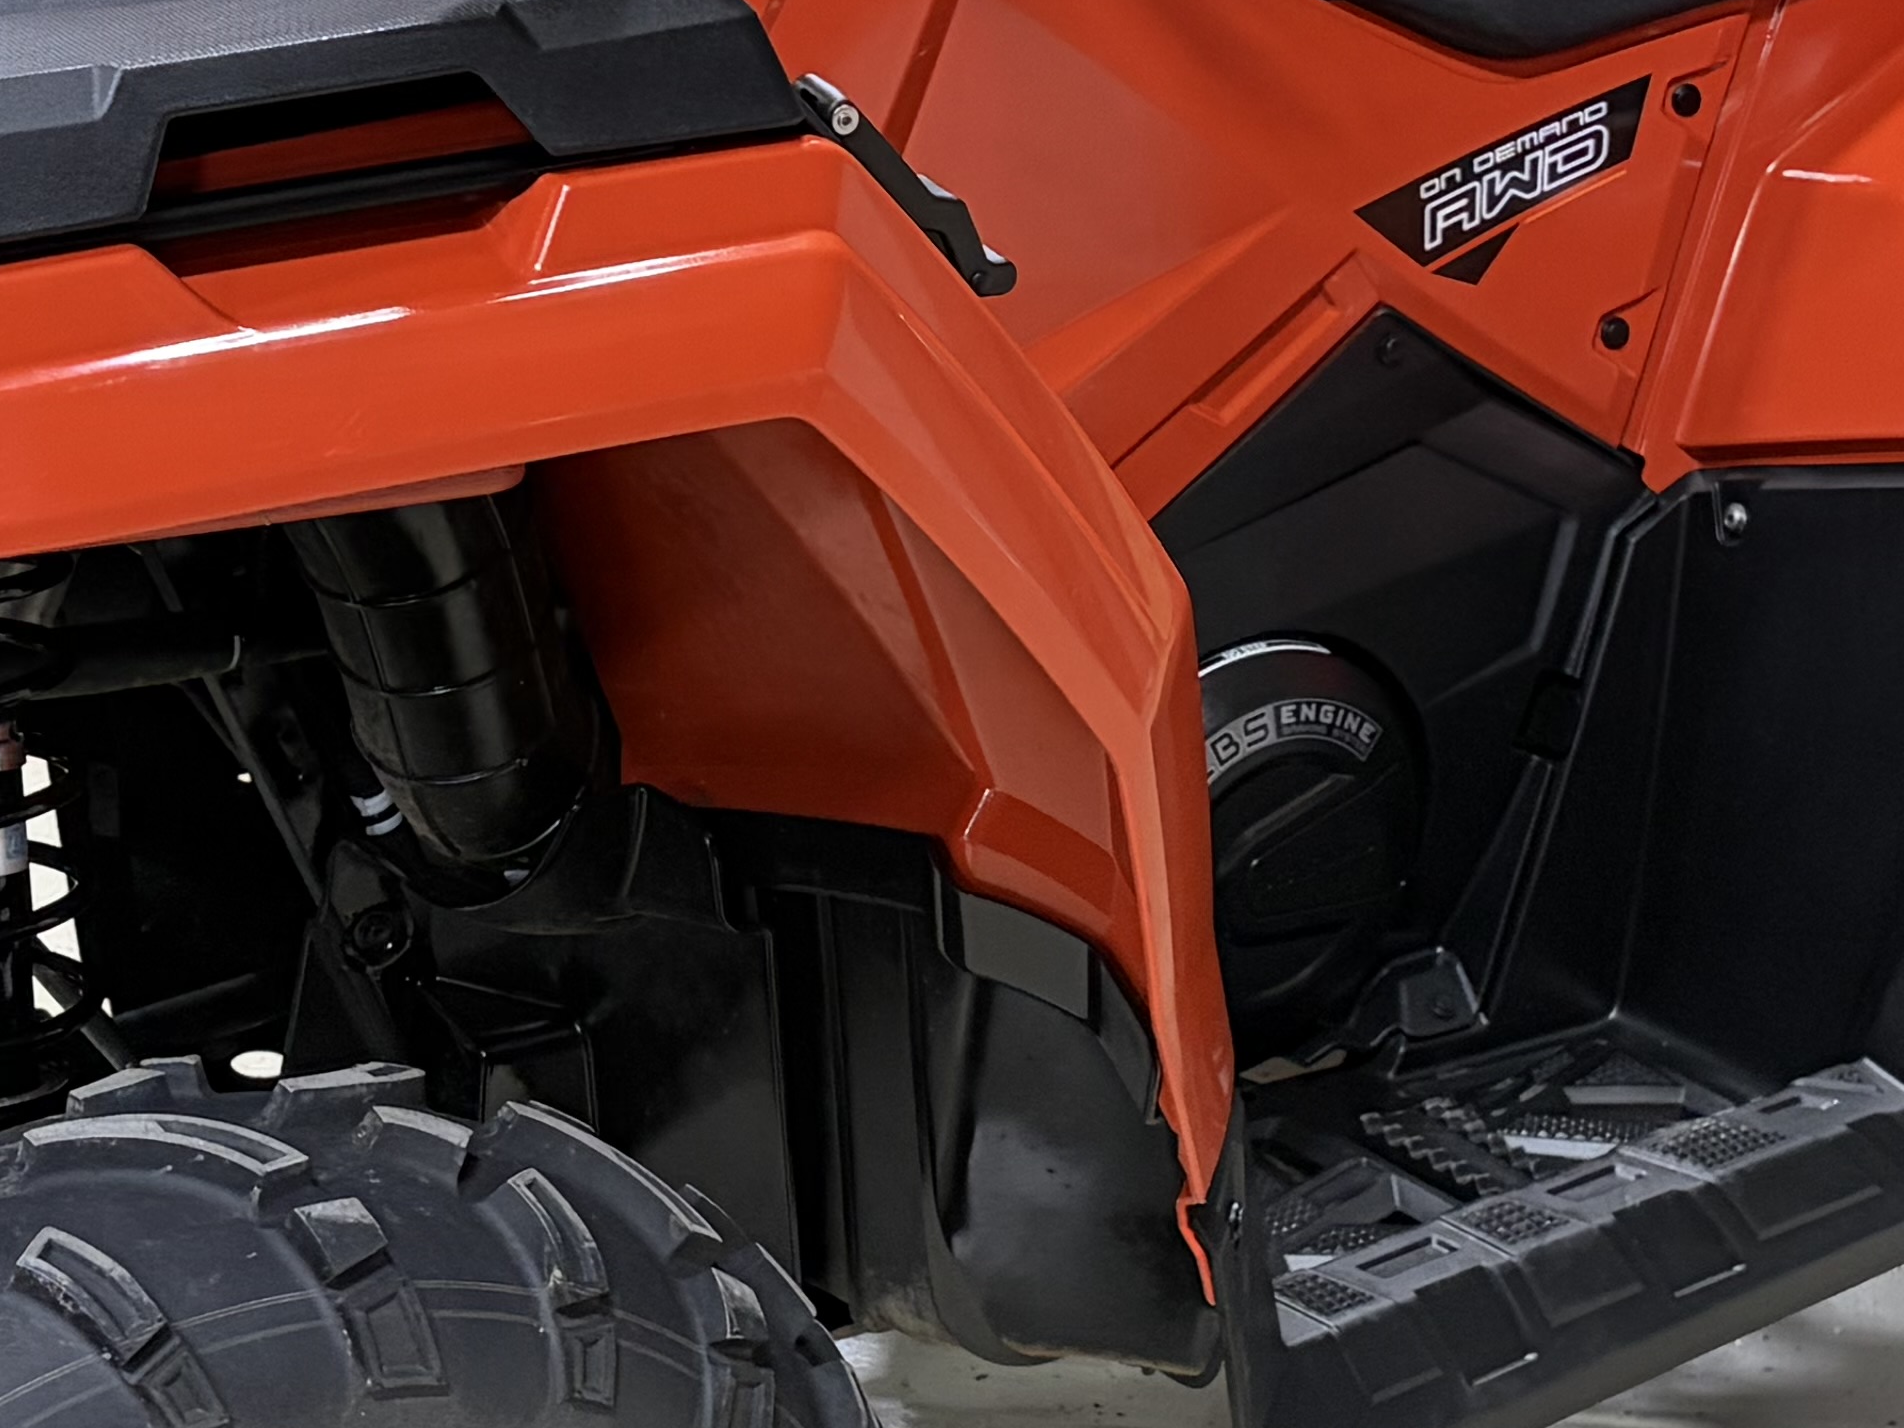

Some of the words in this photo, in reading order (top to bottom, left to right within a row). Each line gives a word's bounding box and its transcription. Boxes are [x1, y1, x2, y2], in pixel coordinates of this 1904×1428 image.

[1420, 167, 1462, 199] ON
[1473, 101, 1608, 174] DEMAND
[1423, 124, 1610, 252] AWD
[1280, 702, 1377, 744] ENGINE
